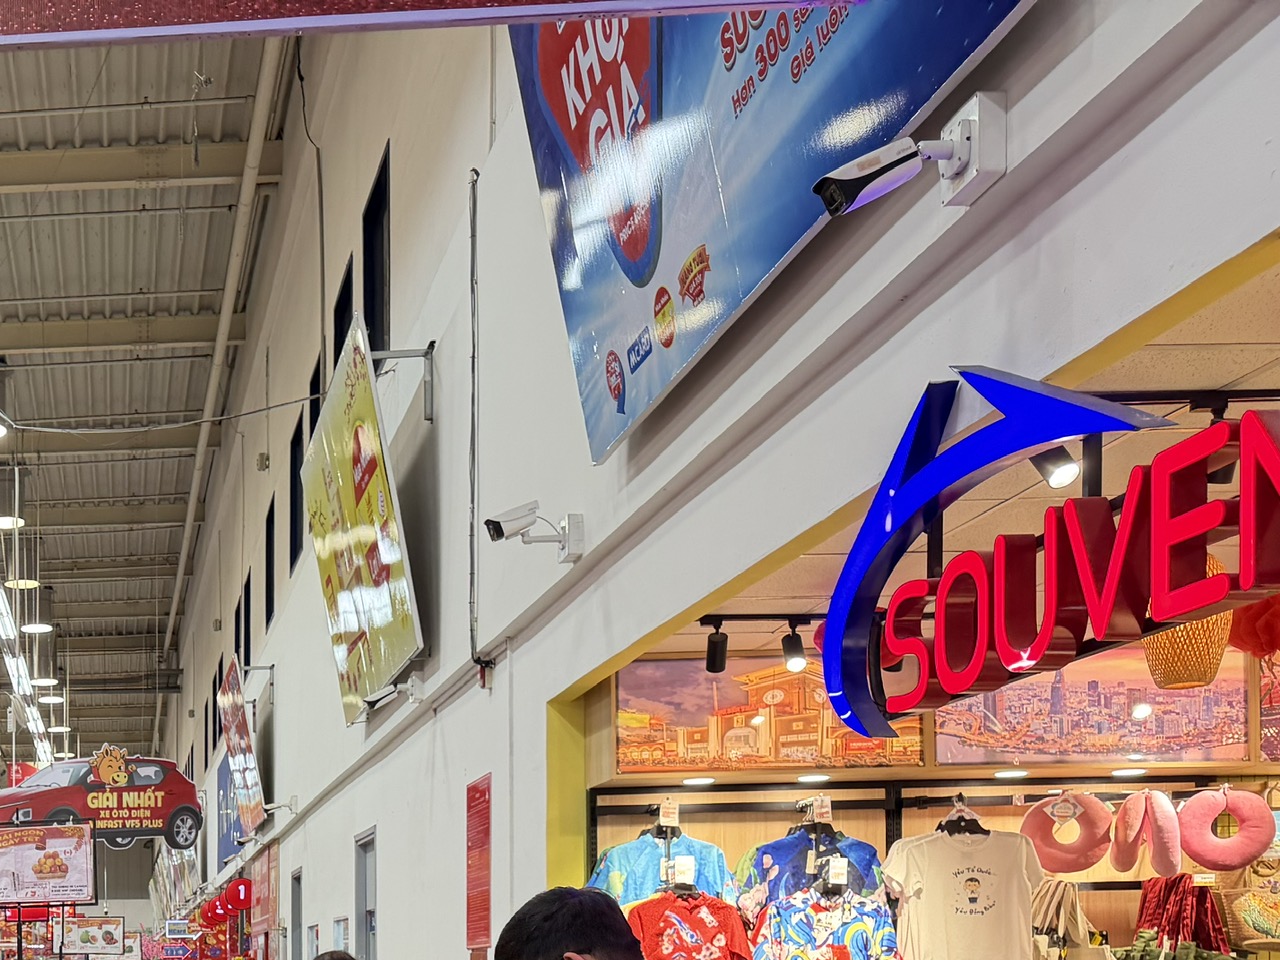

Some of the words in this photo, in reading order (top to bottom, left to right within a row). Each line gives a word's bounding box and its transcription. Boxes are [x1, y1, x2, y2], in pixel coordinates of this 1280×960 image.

[755, 10, 791, 81] 300
[87, 788, 118, 809] GIẢI
[122, 786, 165, 808] NHẤT
[100, 810, 110, 818] XE
[143, 819, 163, 828] PLUS
[238, 884, 246, 900] 1
